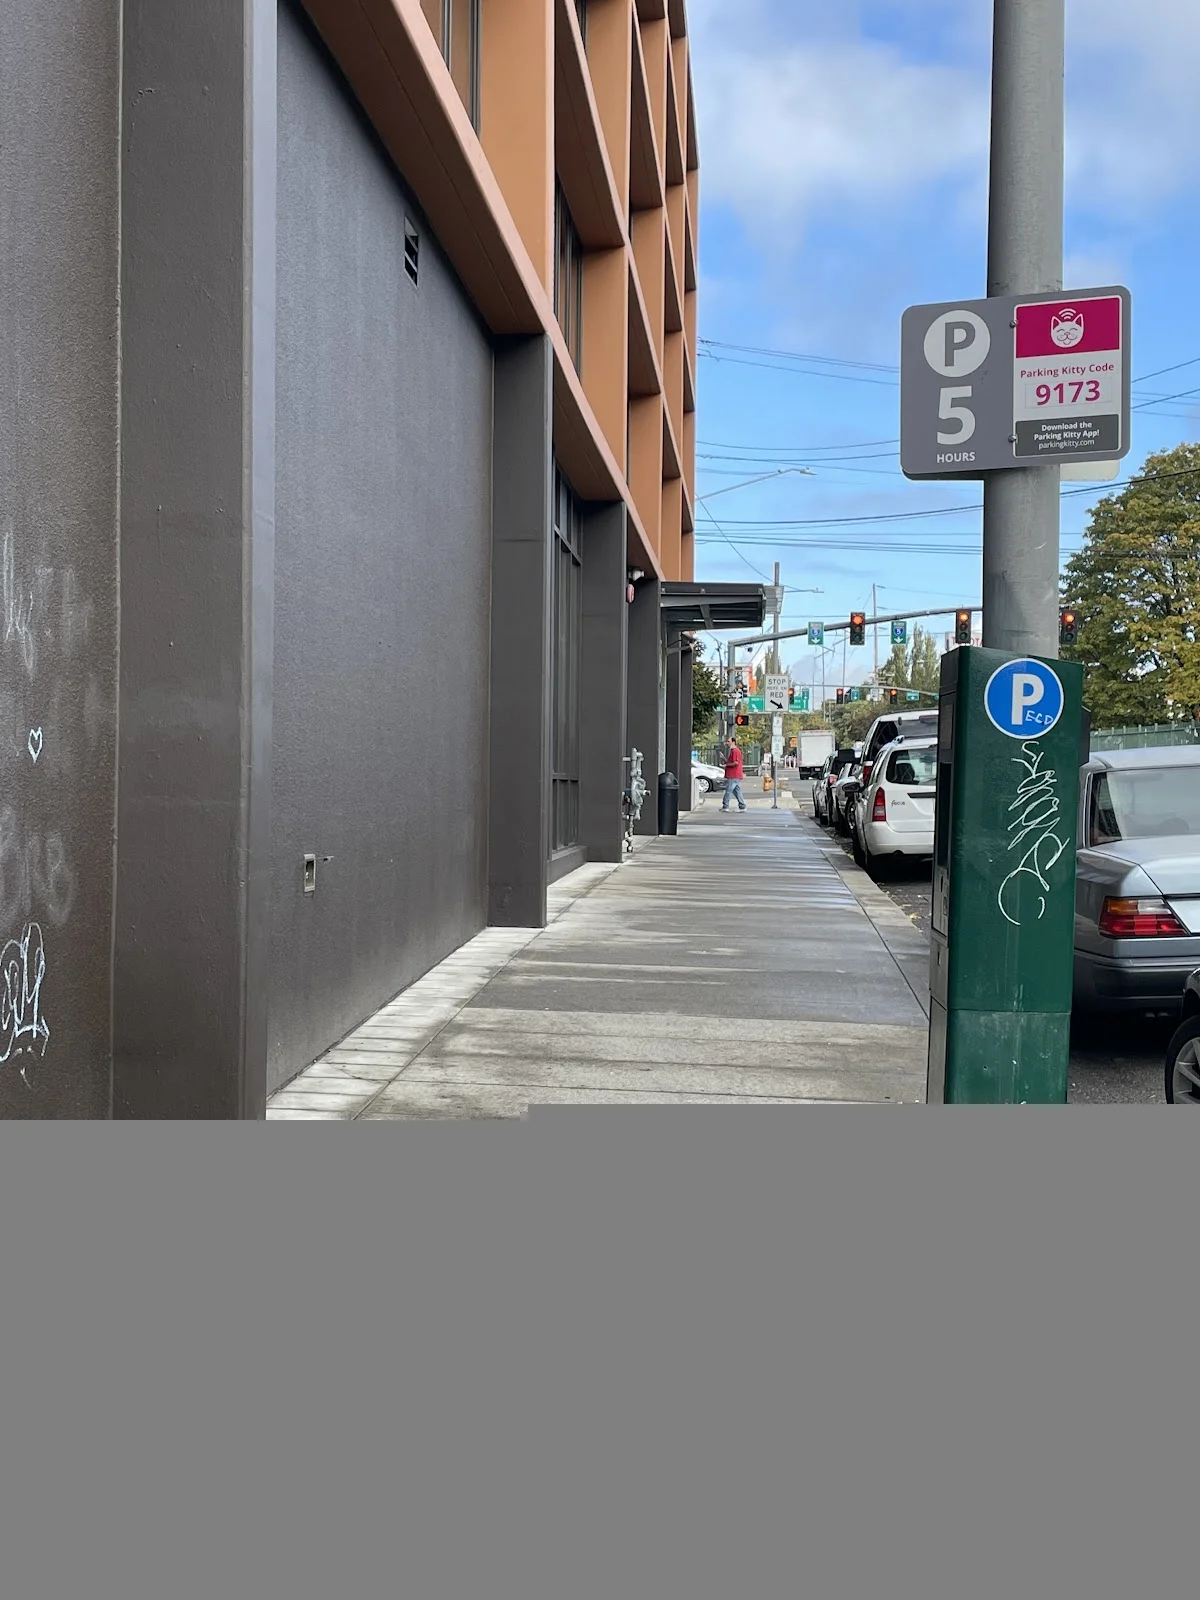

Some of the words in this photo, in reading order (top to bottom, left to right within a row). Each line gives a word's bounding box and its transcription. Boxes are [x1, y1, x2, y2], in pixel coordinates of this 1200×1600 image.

[944, 320, 976, 367] P
[1020, 368, 1059, 378] Parking
[1062, 366, 1086, 376] Kitty
[1089, 363, 1115, 373] Code
[1035, 380, 1101, 406] 9173
[936, 385, 976, 445] 5
[1041, 422, 1078, 431] Download
[1033, 432, 1062, 441] Parking
[1063, 431, 1082, 440] Kitty
[1083, 429, 1100, 438] App!
[1038, 439, 1095, 450] parkingkitty.com
[936, 452, 976, 464] HOURS
[1011, 673, 1045, 725] P
[891, 799, 906, 808] focus
